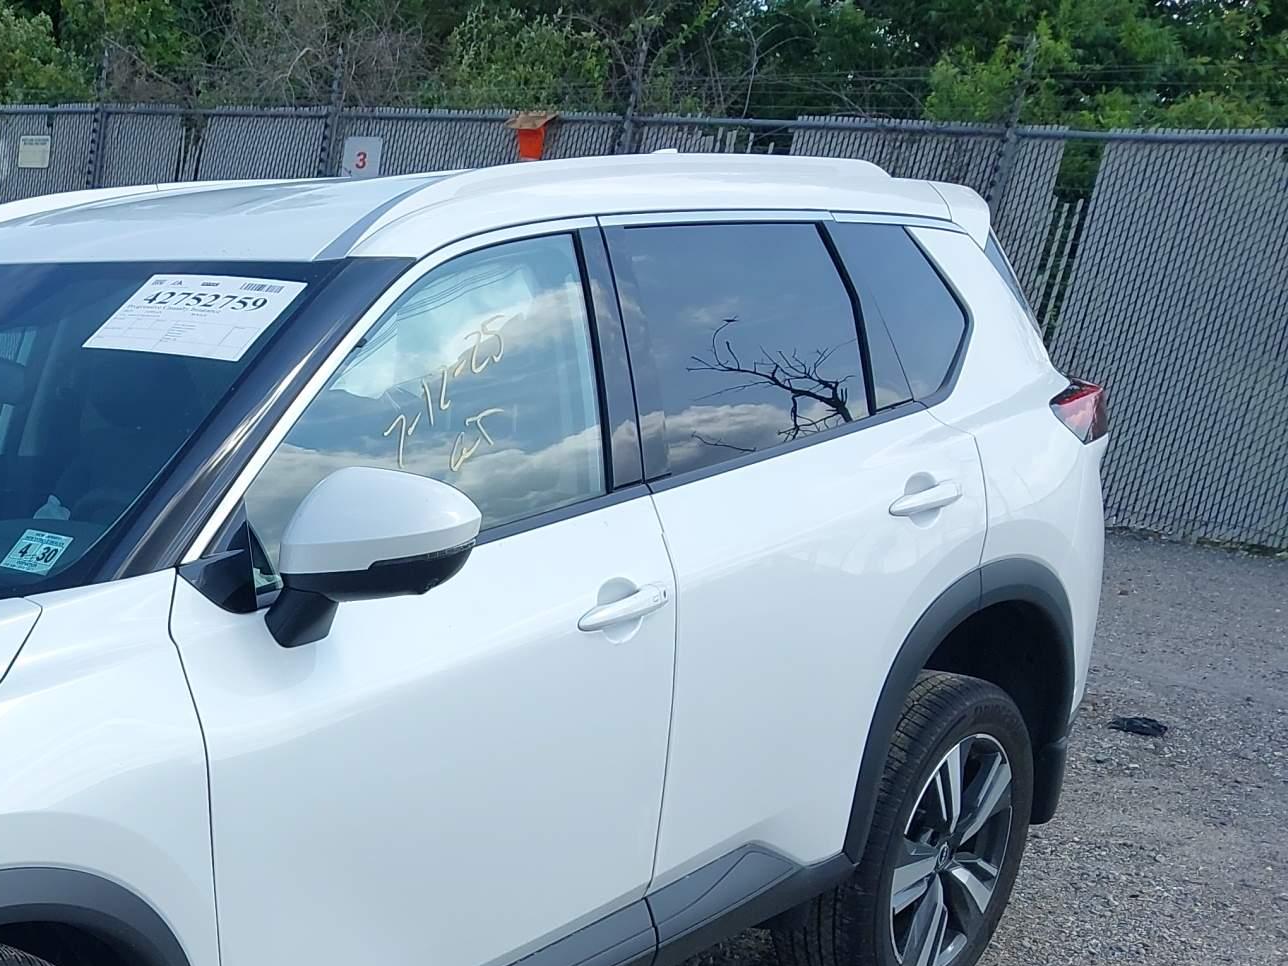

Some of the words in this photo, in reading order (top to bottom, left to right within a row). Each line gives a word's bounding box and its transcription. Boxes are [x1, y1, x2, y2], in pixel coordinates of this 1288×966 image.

[355, 151, 367, 169] 3
[143, 291, 268, 312] 42752759
[18, 543, 32, 558] 4
[36, 546, 58, 563] 30
